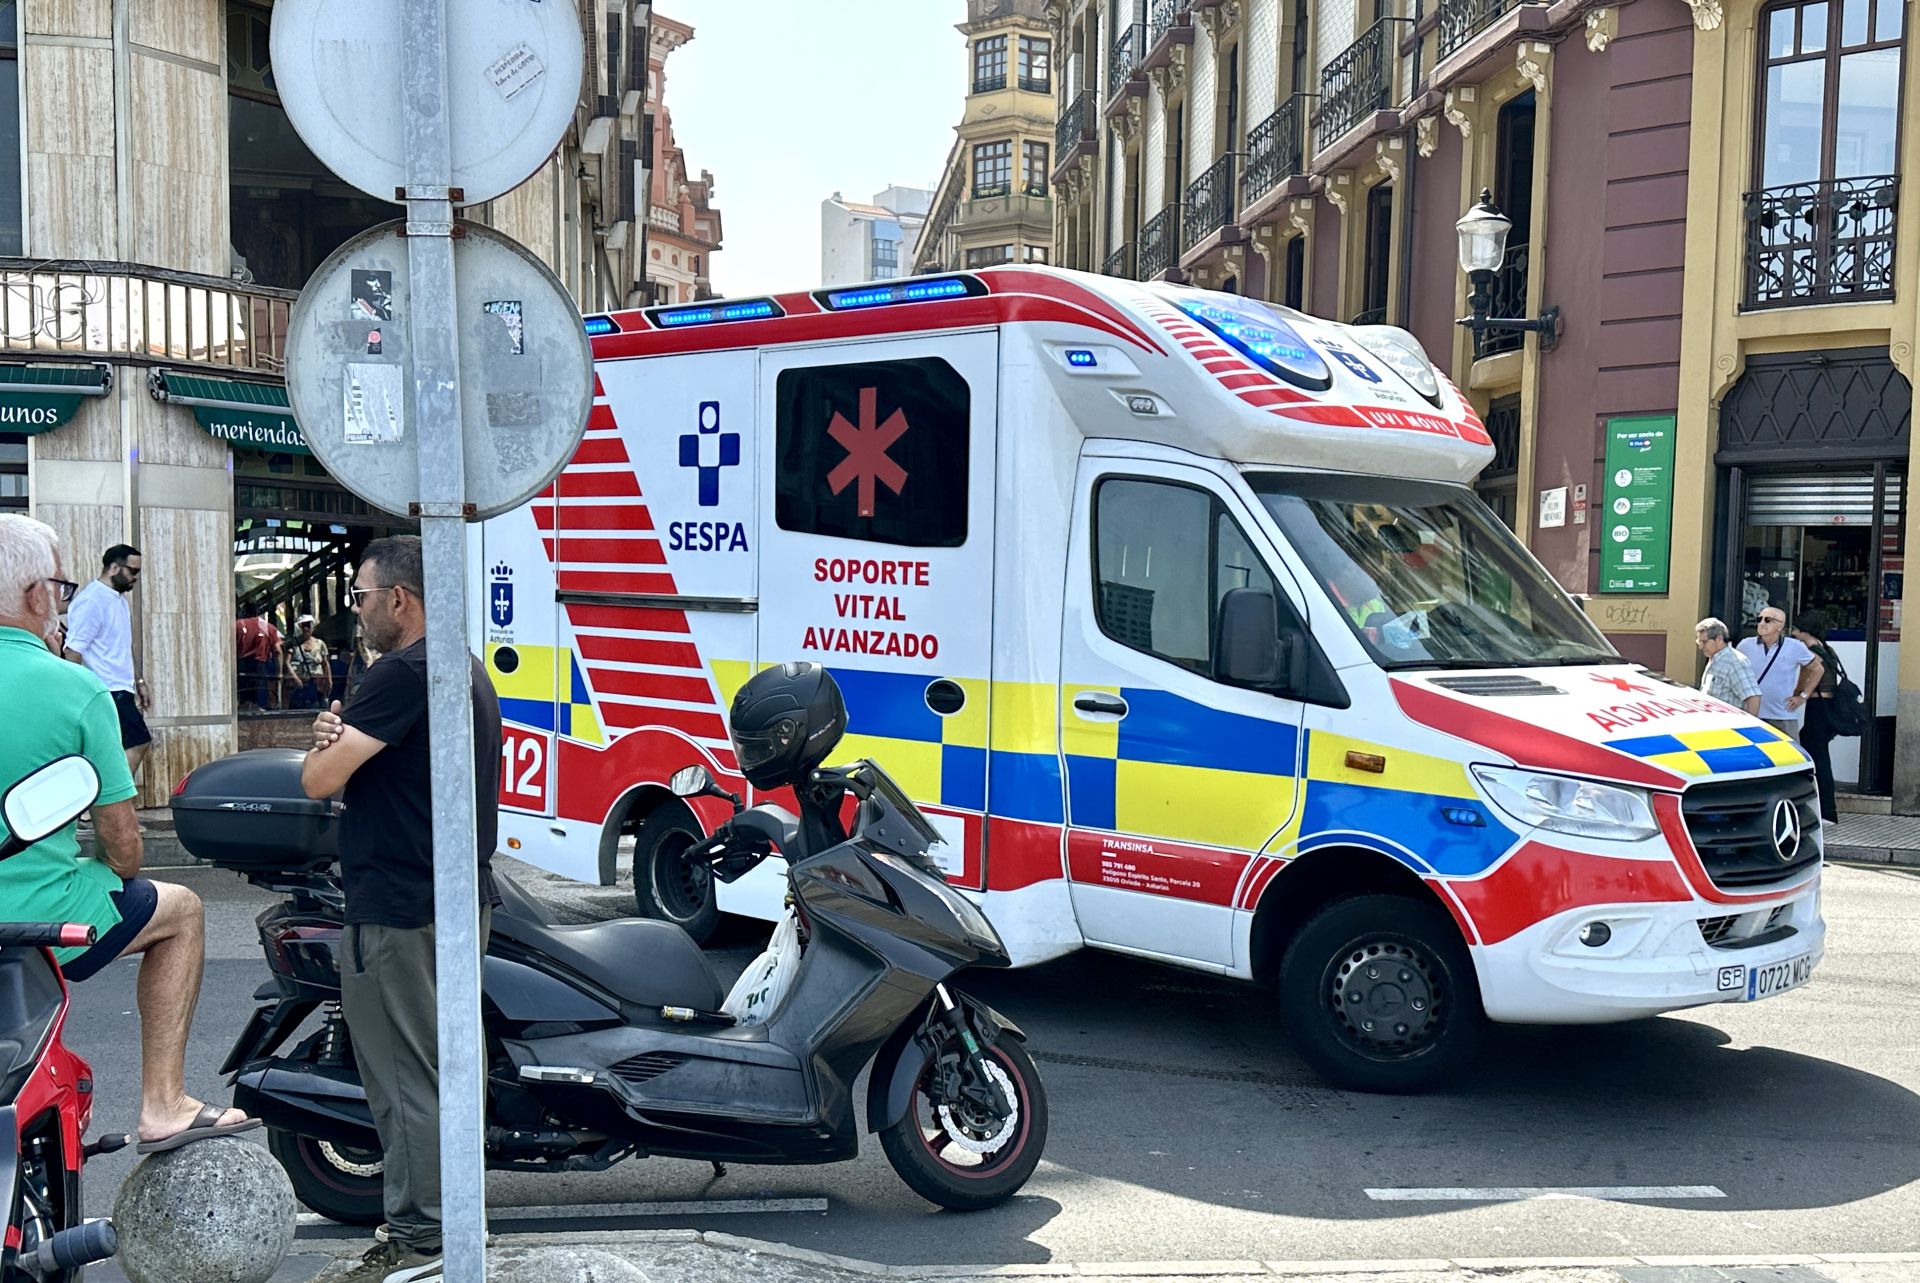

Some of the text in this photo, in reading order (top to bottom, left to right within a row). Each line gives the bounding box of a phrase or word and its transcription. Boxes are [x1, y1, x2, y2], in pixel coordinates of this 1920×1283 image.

[1, 407, 58, 424] unos
[1368, 411, 1404, 426] UVI
[210, 420, 306, 446] meriendas
[668, 521, 749, 552] SESPA
[814, 558, 930, 586] SOPORTE
[834, 594, 906, 621] VITAL
[802, 626, 939, 659] AVANZADO
[1102, 839, 1154, 854] TRANSINSA
[1722, 969, 1742, 987] SP
[1759, 963, 1790, 993] 0722
